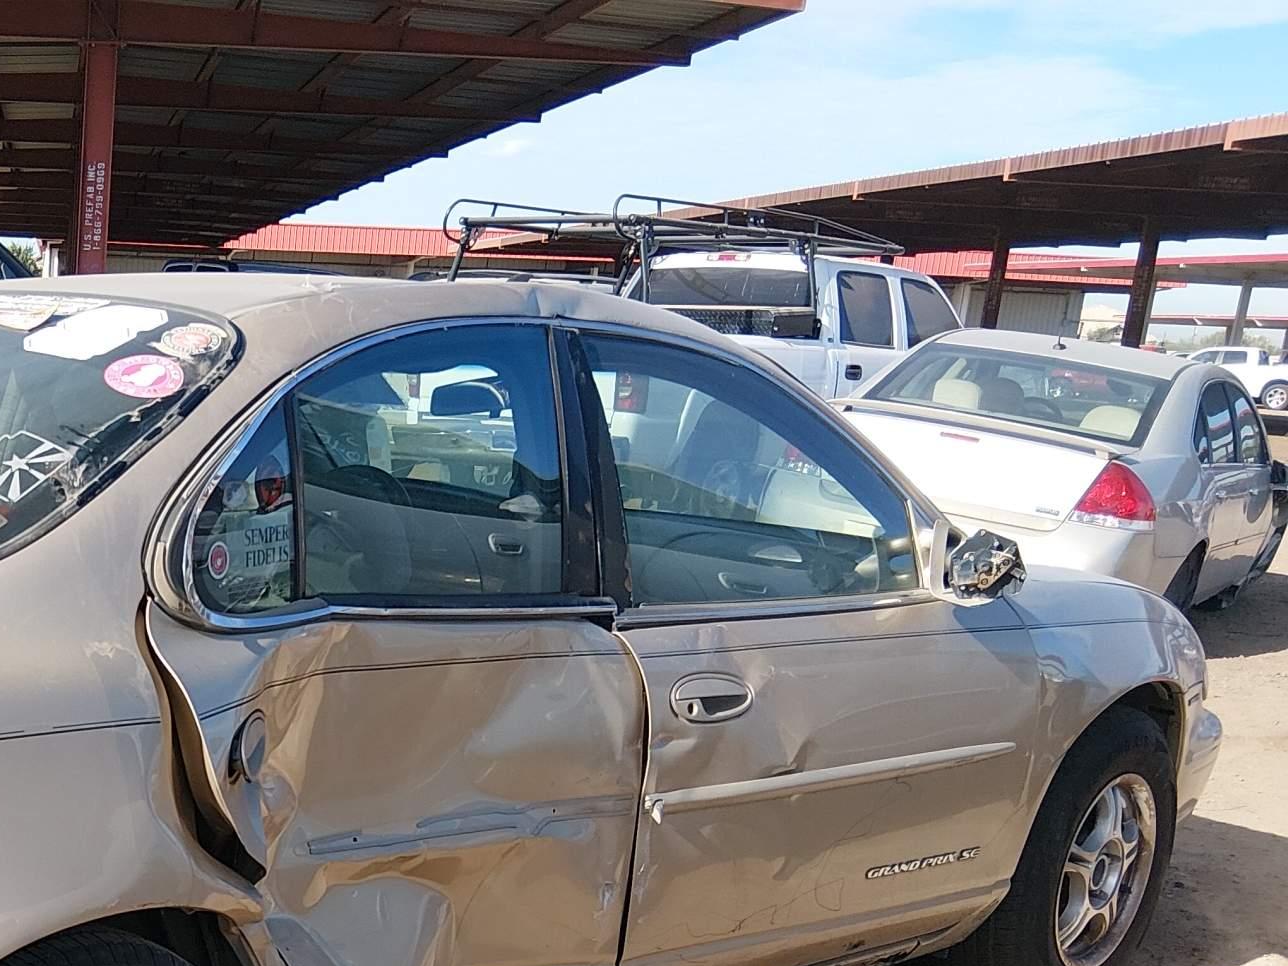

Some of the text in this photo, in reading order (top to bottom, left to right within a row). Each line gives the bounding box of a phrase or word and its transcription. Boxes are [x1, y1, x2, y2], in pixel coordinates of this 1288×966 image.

[85, 186, 95, 226] PREFAB
[244, 525, 289, 547] SEMPER
[245, 547, 289, 568] FIDELIS
[866, 859, 921, 880] GRAND
[920, 850, 959, 870] PRIX
